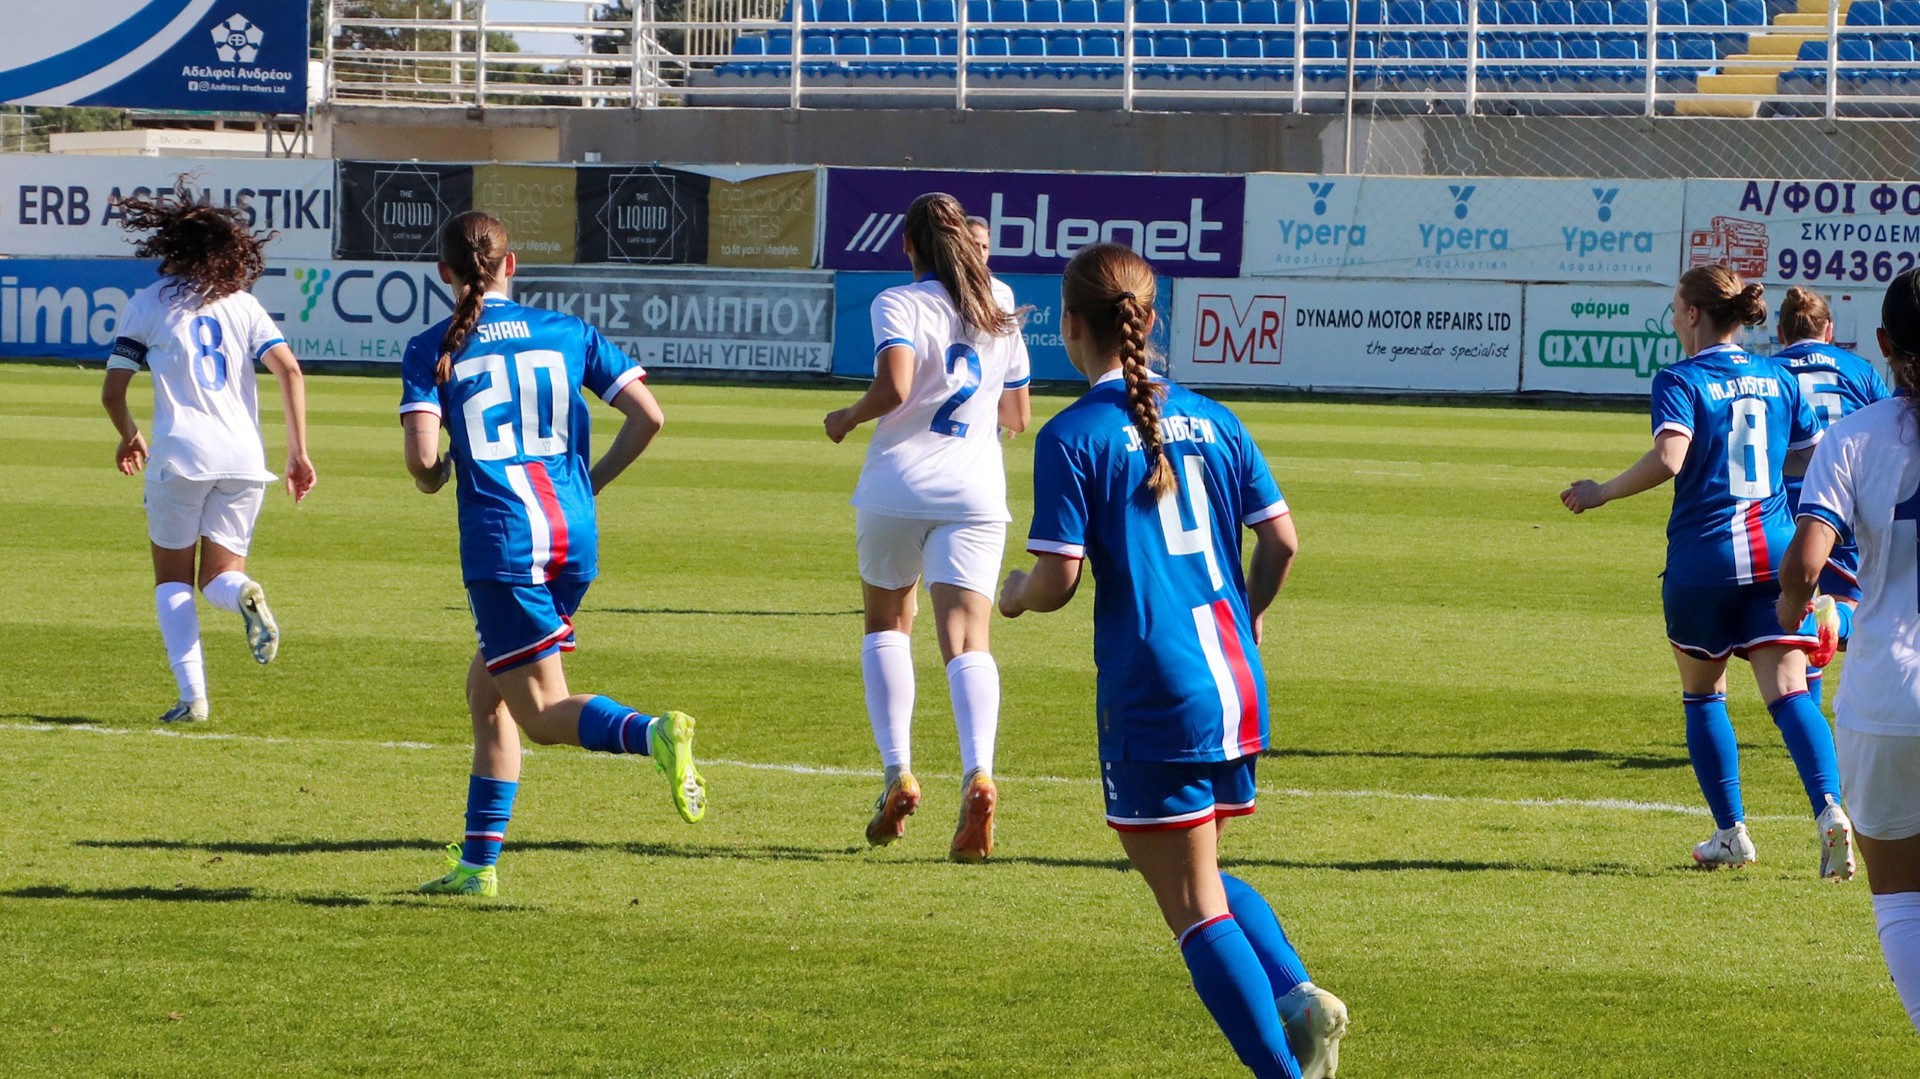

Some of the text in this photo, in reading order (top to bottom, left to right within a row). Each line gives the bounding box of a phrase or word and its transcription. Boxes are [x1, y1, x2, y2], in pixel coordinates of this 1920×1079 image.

[182, 65, 293, 82] Αδελφοί Ανδρέου
[210, 83, 240, 92] Andreou
[273, 86, 286, 94] Ltd
[19, 185, 91, 226] ERB
[400, 190, 414, 198] THE
[636, 193, 649, 201] THE
[383, 202, 432, 227] LIQUID
[617, 205, 667, 231] LIQUID
[720, 215, 780, 238] TASTES
[967, 192, 1223, 262] blenet
[721, 244, 731, 254] to
[741, 246, 763, 257] your
[1278, 219, 1366, 251] Ypera
[1419, 223, 1509, 254] Ypera
[1561, 226, 1653, 258] Ypera
[1778, 248, 1920, 283] 994362
[1, 276, 145, 346] ima
[642, 295, 827, 335] ΦΙΛΙΠΠΟΥ
[1033, 305, 1051, 325] of
[1296, 308, 1511, 332] DYNAMO MOTOR REPAIRS LTD
[1571, 297, 1630, 319] φάρμα
[477, 320, 531, 344] SHAKI
[1195, 297, 1284, 364] DMR
[189, 315, 227, 392] 8
[291, 337, 401, 357] IMAL HEA
[1366, 341, 1509, 362] the generator specialist
[1543, 334, 1690, 374] αχναγα
[454, 349, 570, 461] 20
[929, 342, 982, 439] 2
[1727, 397, 1772, 500] 8
[1152, 454, 1224, 592] 4
